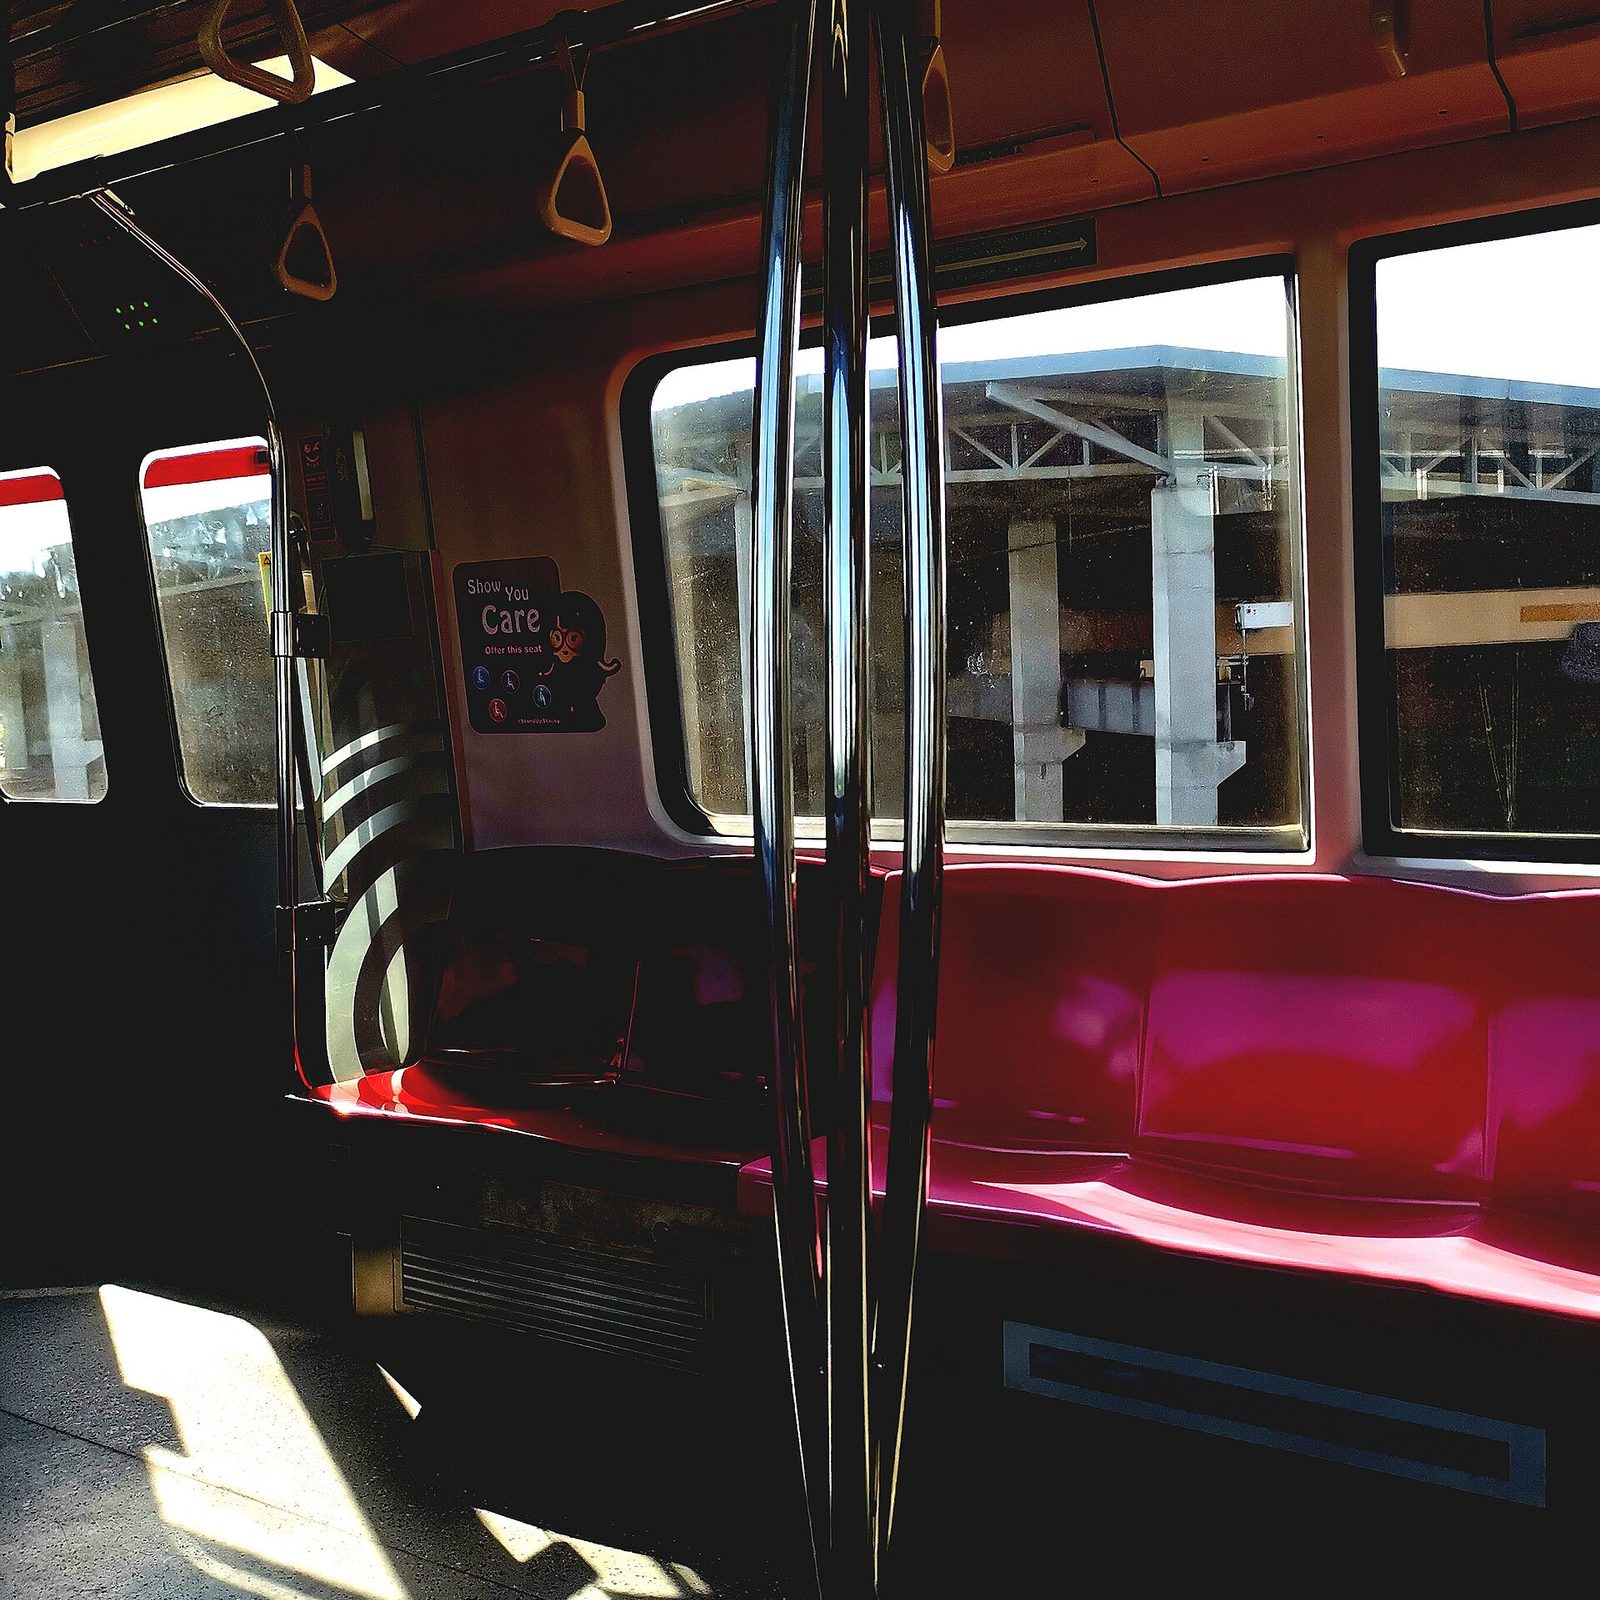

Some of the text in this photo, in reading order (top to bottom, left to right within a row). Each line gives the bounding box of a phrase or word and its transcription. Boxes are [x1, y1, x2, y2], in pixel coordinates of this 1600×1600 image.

[467, 579, 529, 602] Show You
[482, 604, 541, 635] Care
[485, 645, 542, 655] Offer this seat
